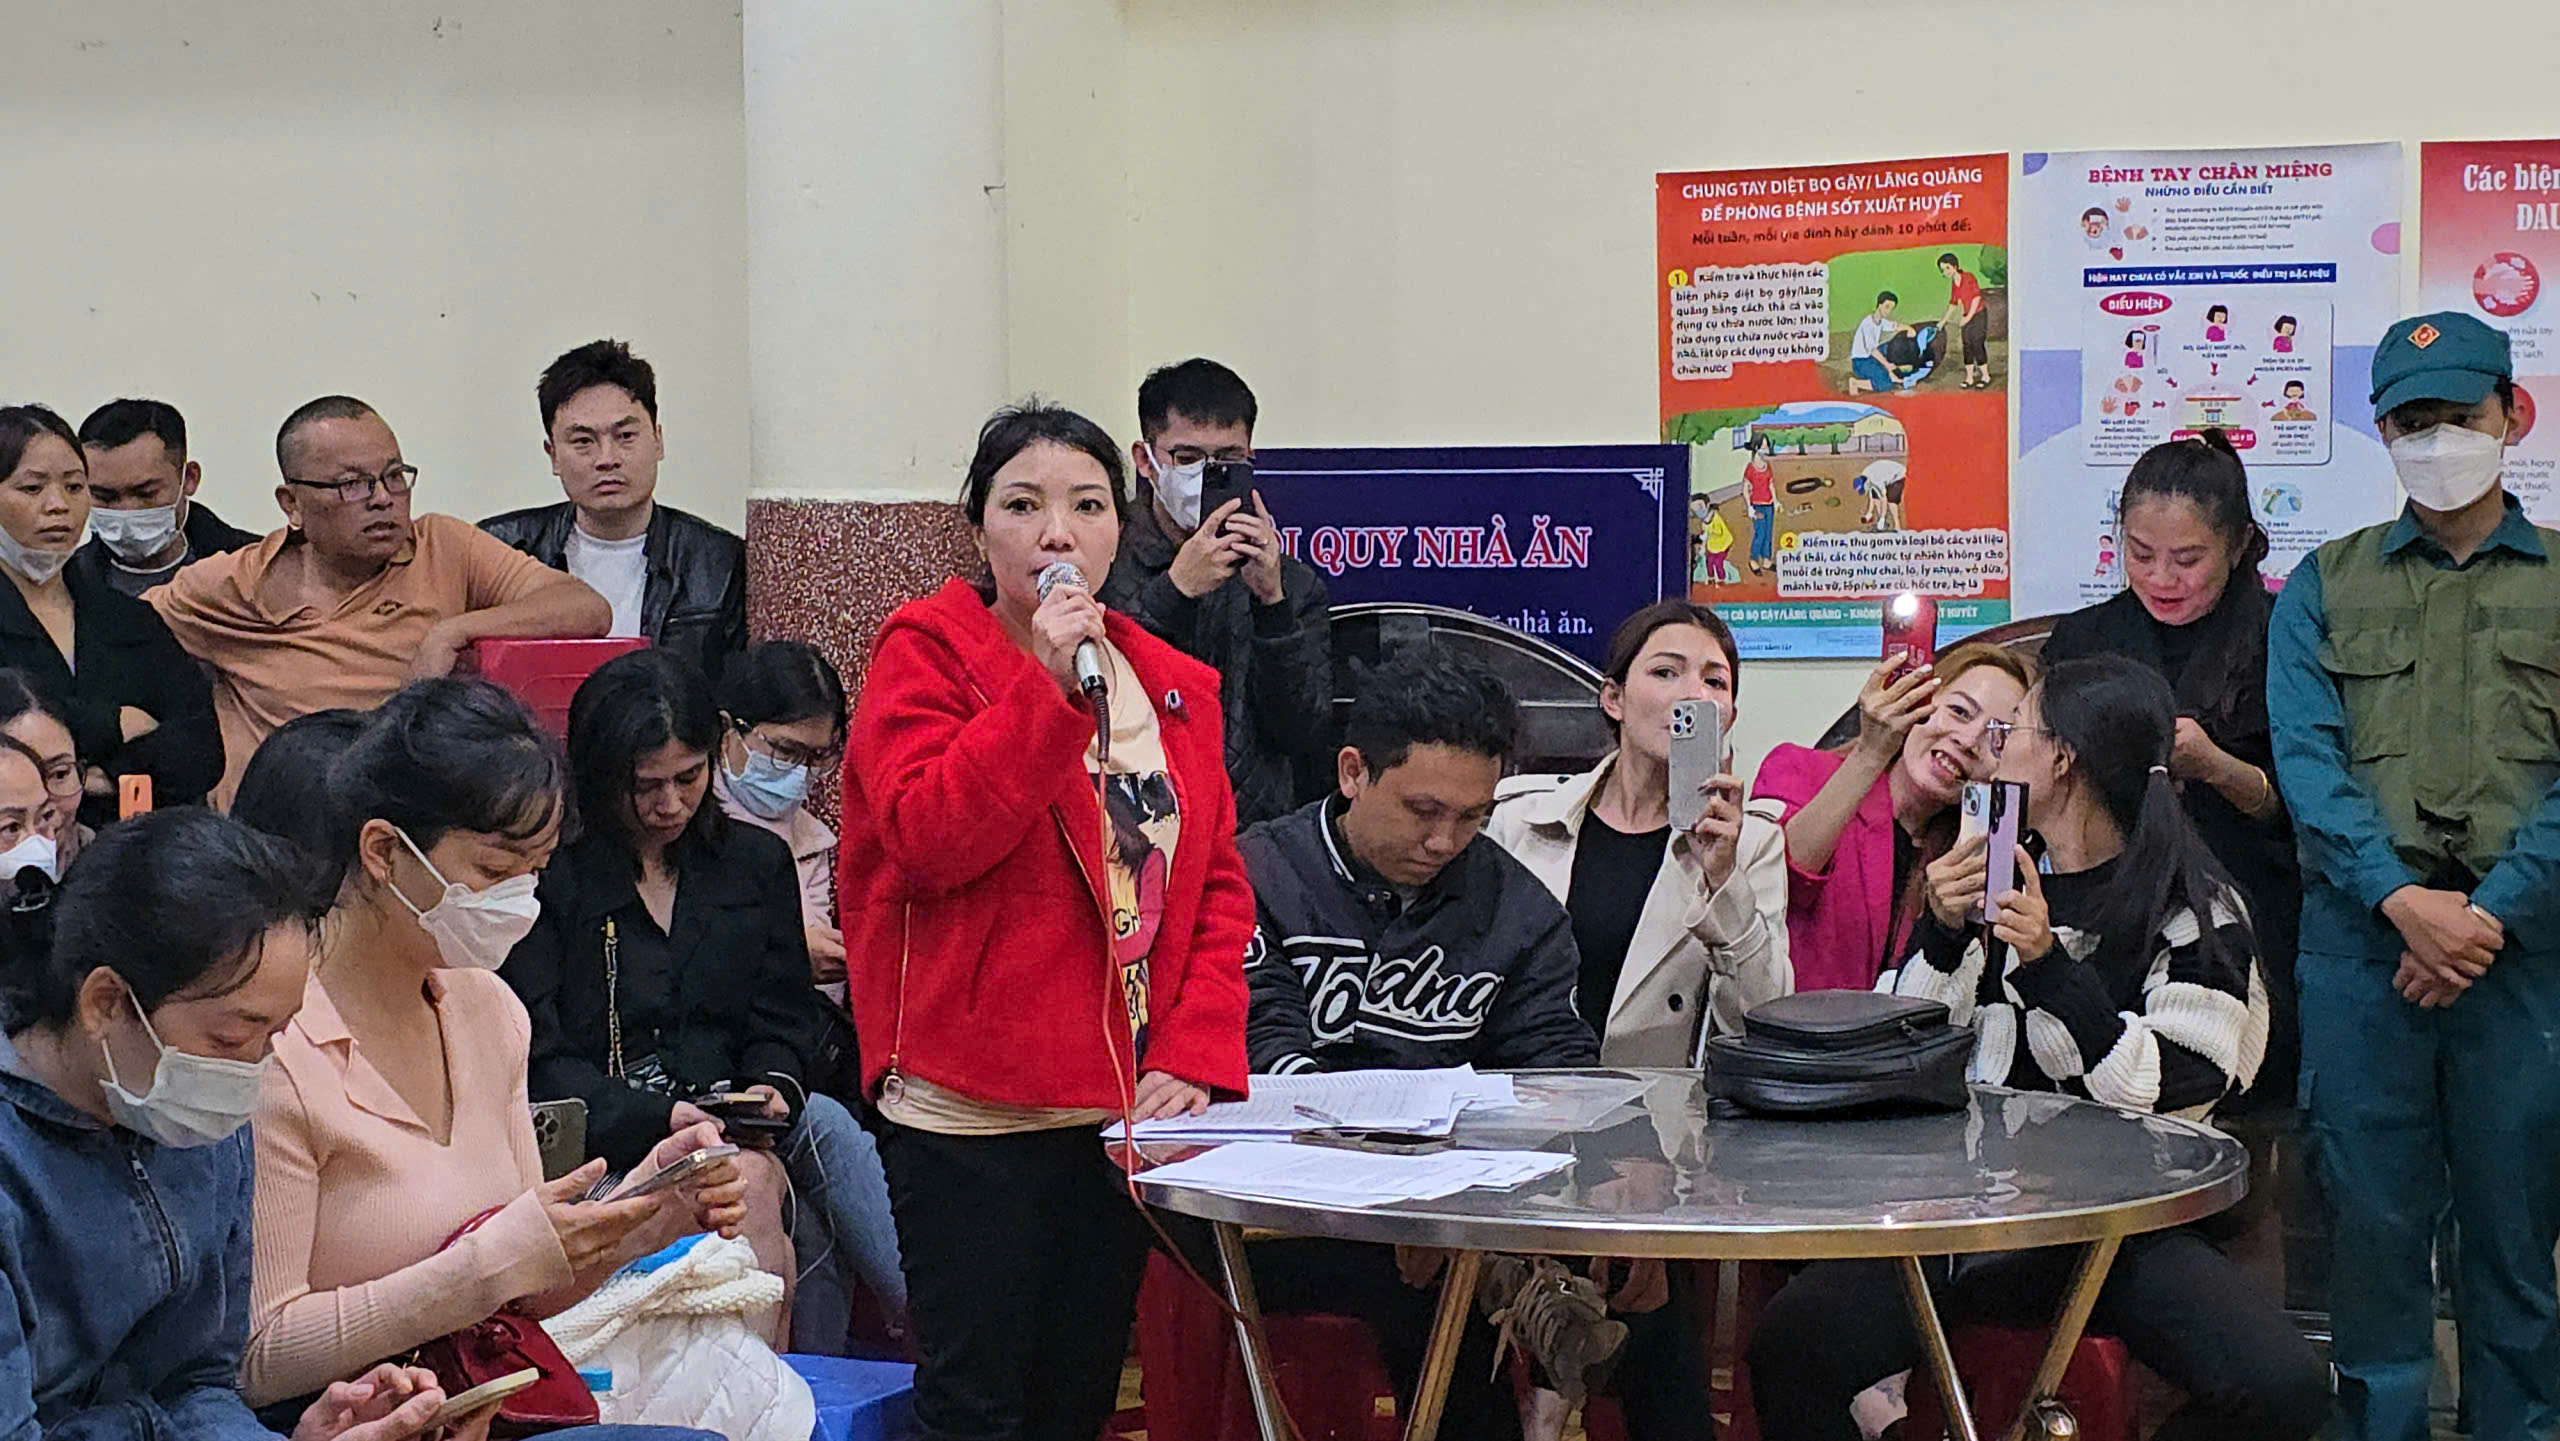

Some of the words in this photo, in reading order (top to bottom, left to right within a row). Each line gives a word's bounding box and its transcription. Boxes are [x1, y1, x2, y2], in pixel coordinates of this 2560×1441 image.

[1682, 183, 1738, 199] CHUNG
[1740, 180, 1767, 196] TAY
[1771, 176, 1806, 197] DIỆT
[1809, 177, 1831, 197] BỌ
[1875, 171, 1919, 189] LĂNG
[1922, 167, 1983, 188] QUĂNG
[2088, 165, 2144, 187] BỆNH
[2151, 167, 2192, 182] TAY
[2198, 162, 2257, 181] CHÂN
[2265, 160, 2332, 182] MIỆNG
[2463, 164, 2507, 191] Các
[2145, 185, 2190, 197] NHỮNG
[2250, 182, 2273, 195] BIẾT
[1701, 203, 1723, 222] ĐỂ
[1725, 202, 1782, 221] PHÒNG
[1786, 200, 1827, 221] BỆNH
[1831, 195, 1862, 216] SỐT
[1864, 193, 1906, 214] XUẤT
[1909, 190, 1963, 215] HUYẾT
[1898, 223, 1914, 235] 10
[1917, 219, 1946, 237] phút
[1674, 273, 1682, 285] 1
[1310, 525, 1408, 576] QUY
[1416, 514, 1517, 569] NHÀ
[1522, 515, 1593, 569] ĂN
[1785, 536, 1794, 548] 2
[1850, 536, 1868, 547] thu
[1869, 538, 1893, 549] gom
[1507, 609, 1551, 634] nhà
[1558, 611, 1593, 634] ăn.
